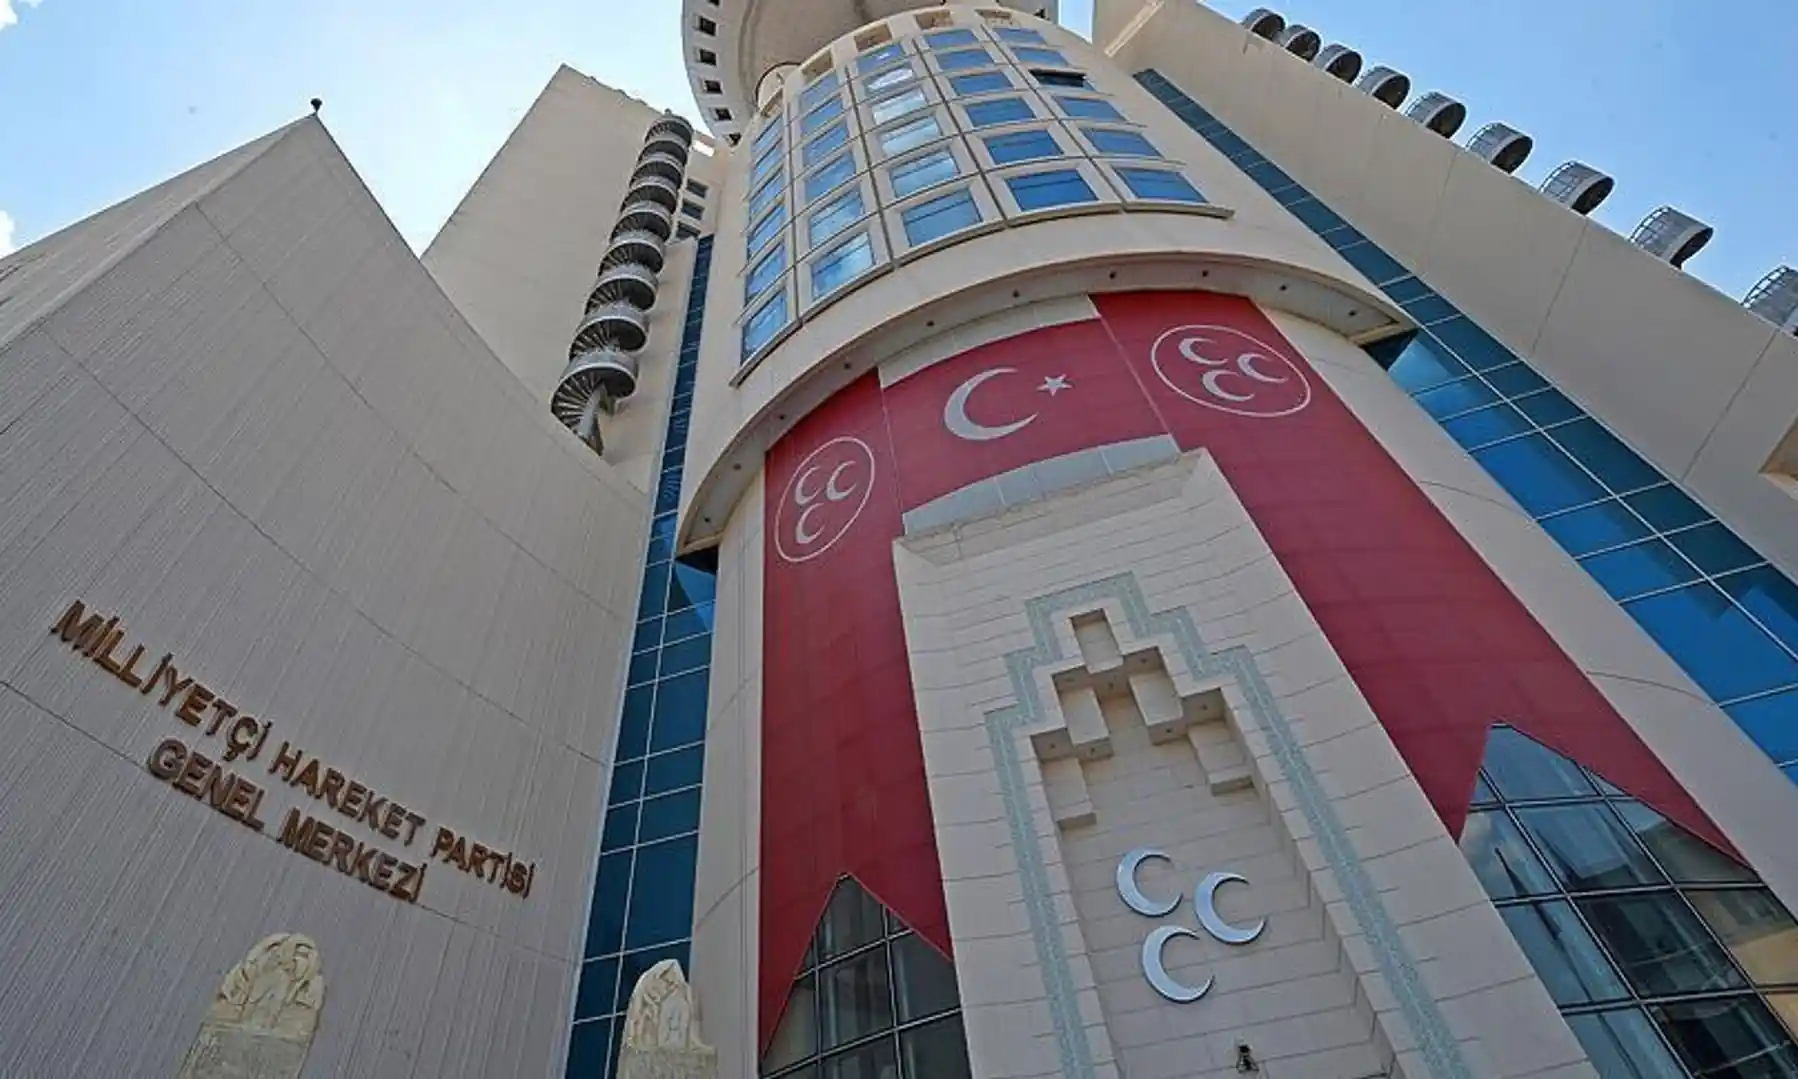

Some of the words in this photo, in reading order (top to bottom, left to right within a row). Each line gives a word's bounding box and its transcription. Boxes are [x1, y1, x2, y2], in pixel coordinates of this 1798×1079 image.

[50, 600, 272, 762] MİLLİYETÇİ
[268, 741, 426, 847] HAREKET
[430, 826, 535, 899] PARTİSİ
[147, 737, 266, 832] GENEL
[276, 807, 428, 903] MERKEZİ
